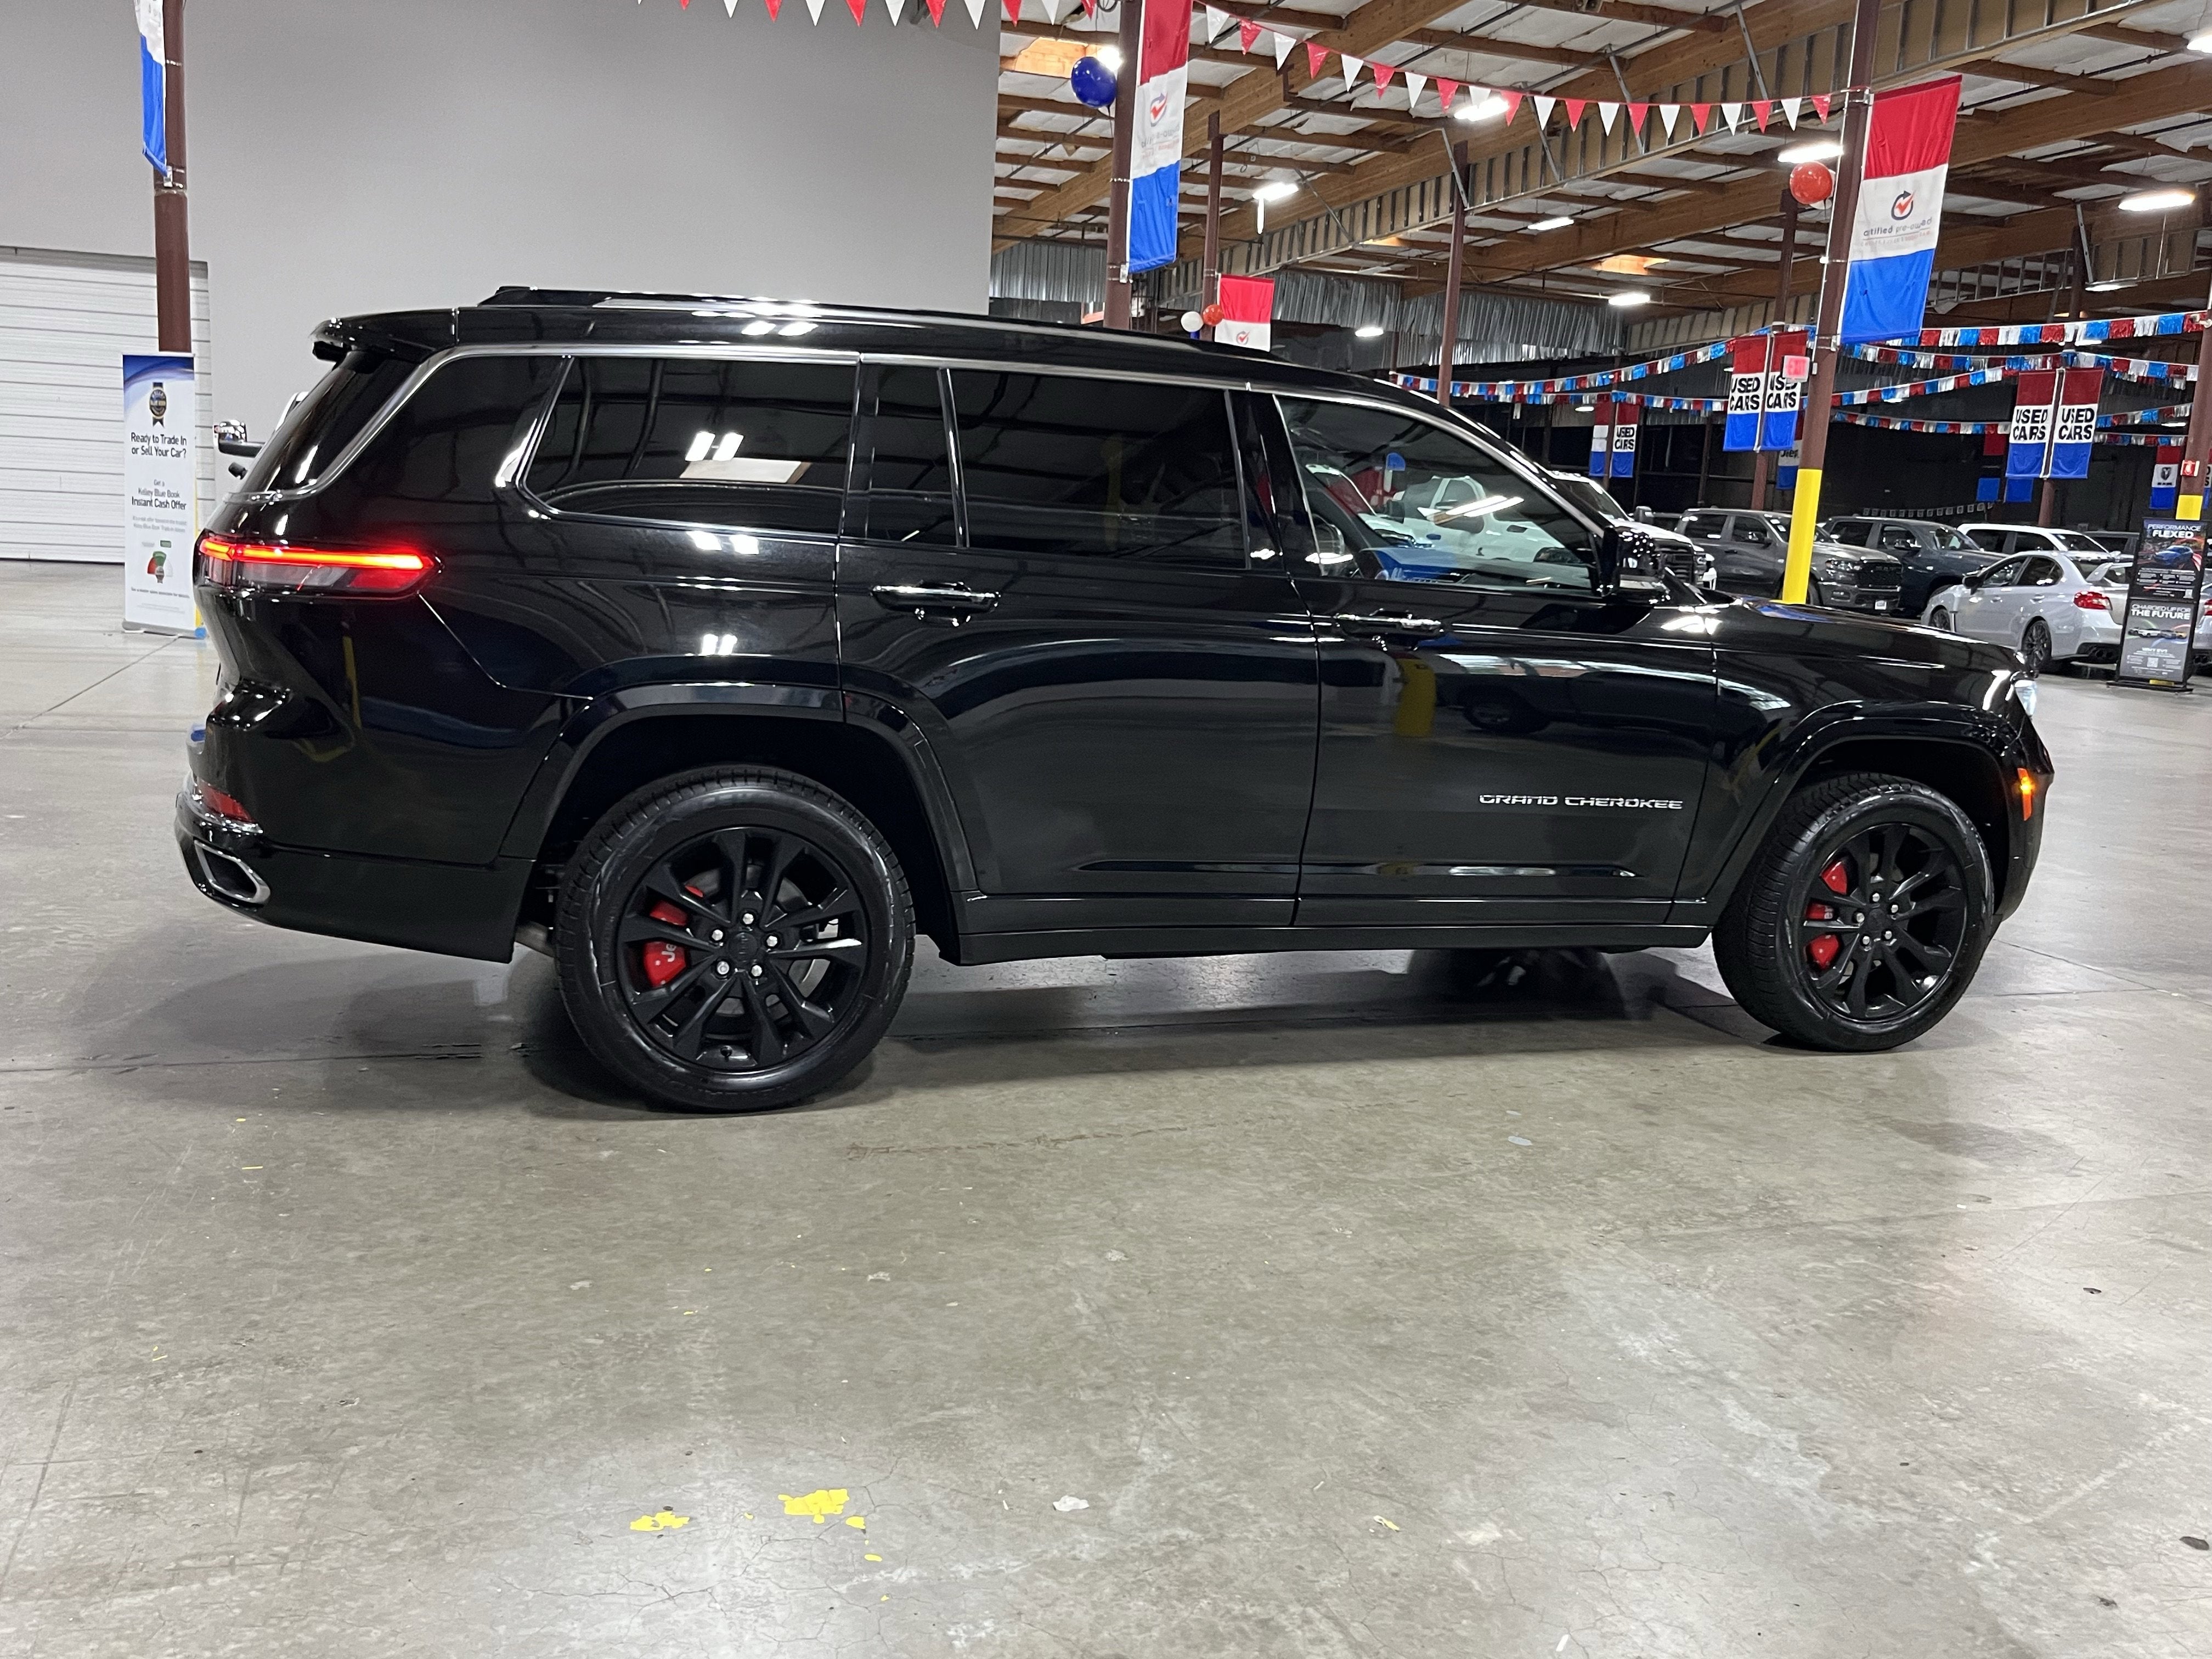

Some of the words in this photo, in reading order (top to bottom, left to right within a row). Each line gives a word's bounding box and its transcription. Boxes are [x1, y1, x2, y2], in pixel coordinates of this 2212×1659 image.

[1863, 225, 1893, 236] ctified
[1730, 377, 1760, 393] USED
[1769, 374, 1798, 391] US
[1730, 394, 1760, 411] CARS
[1767, 391, 1797, 409] CARS
[2016, 409, 2048, 424] USED
[2062, 408, 2095, 424] USED
[131, 432, 151, 445] Ready
[153, 434, 159, 444] to
[160, 433, 179, 445] Trade
[180, 435, 187, 445] In
[1616, 427, 1635, 438] USED
[2013, 425, 2046, 440] CARS
[2058, 424, 2093, 440] CARS
[132, 447, 139, 455] or
[141, 445, 153, 456] Sell
[154, 446, 169, 457] Your
[171, 447, 187, 459] Car?
[167, 489, 180, 498] Book
[132, 496, 153, 507] Instant
[154, 498, 170, 509] Cash
[171, 500, 187, 510] Offer
[2147, 523, 2202, 532] PERFORMANCE
[2152, 529, 2194, 539] FLEXED
[2151, 610, 2191, 620] FUTURE
[1479, 794, 1558, 805] GRAND
[1565, 797, 1683, 809] CHEROKEE
[661, 943, 678, 962] Je
